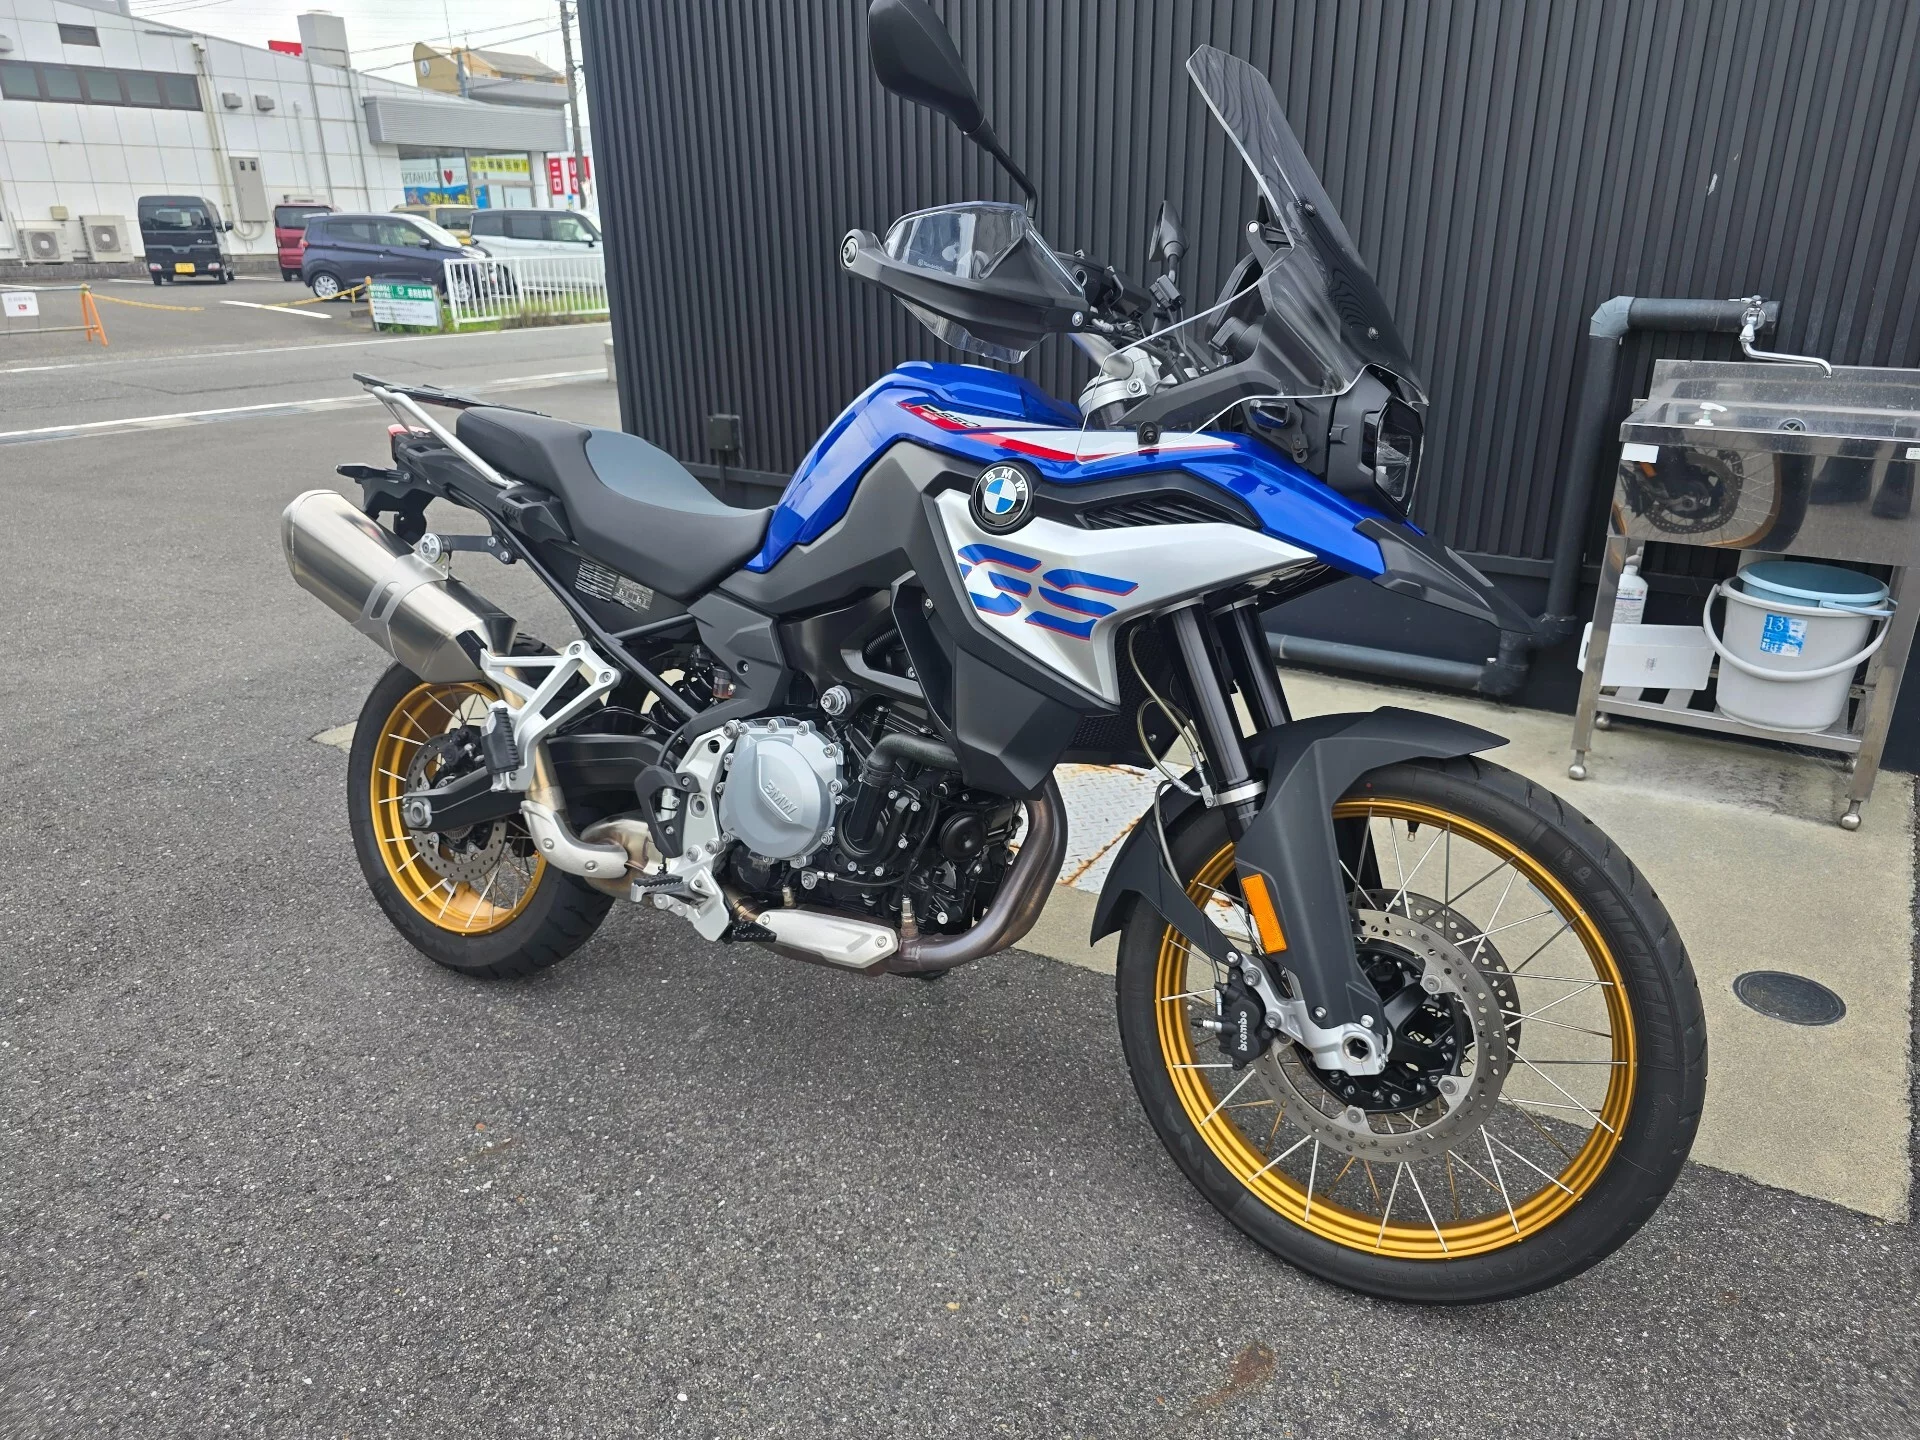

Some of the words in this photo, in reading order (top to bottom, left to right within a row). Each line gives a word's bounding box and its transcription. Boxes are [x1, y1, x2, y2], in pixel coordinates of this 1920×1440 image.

[985, 468, 1026, 492] BMW
[957, 543, 1139, 641] GS
[764, 779, 798, 815] BMW
[1237, 1010, 1248, 1052] brembo
